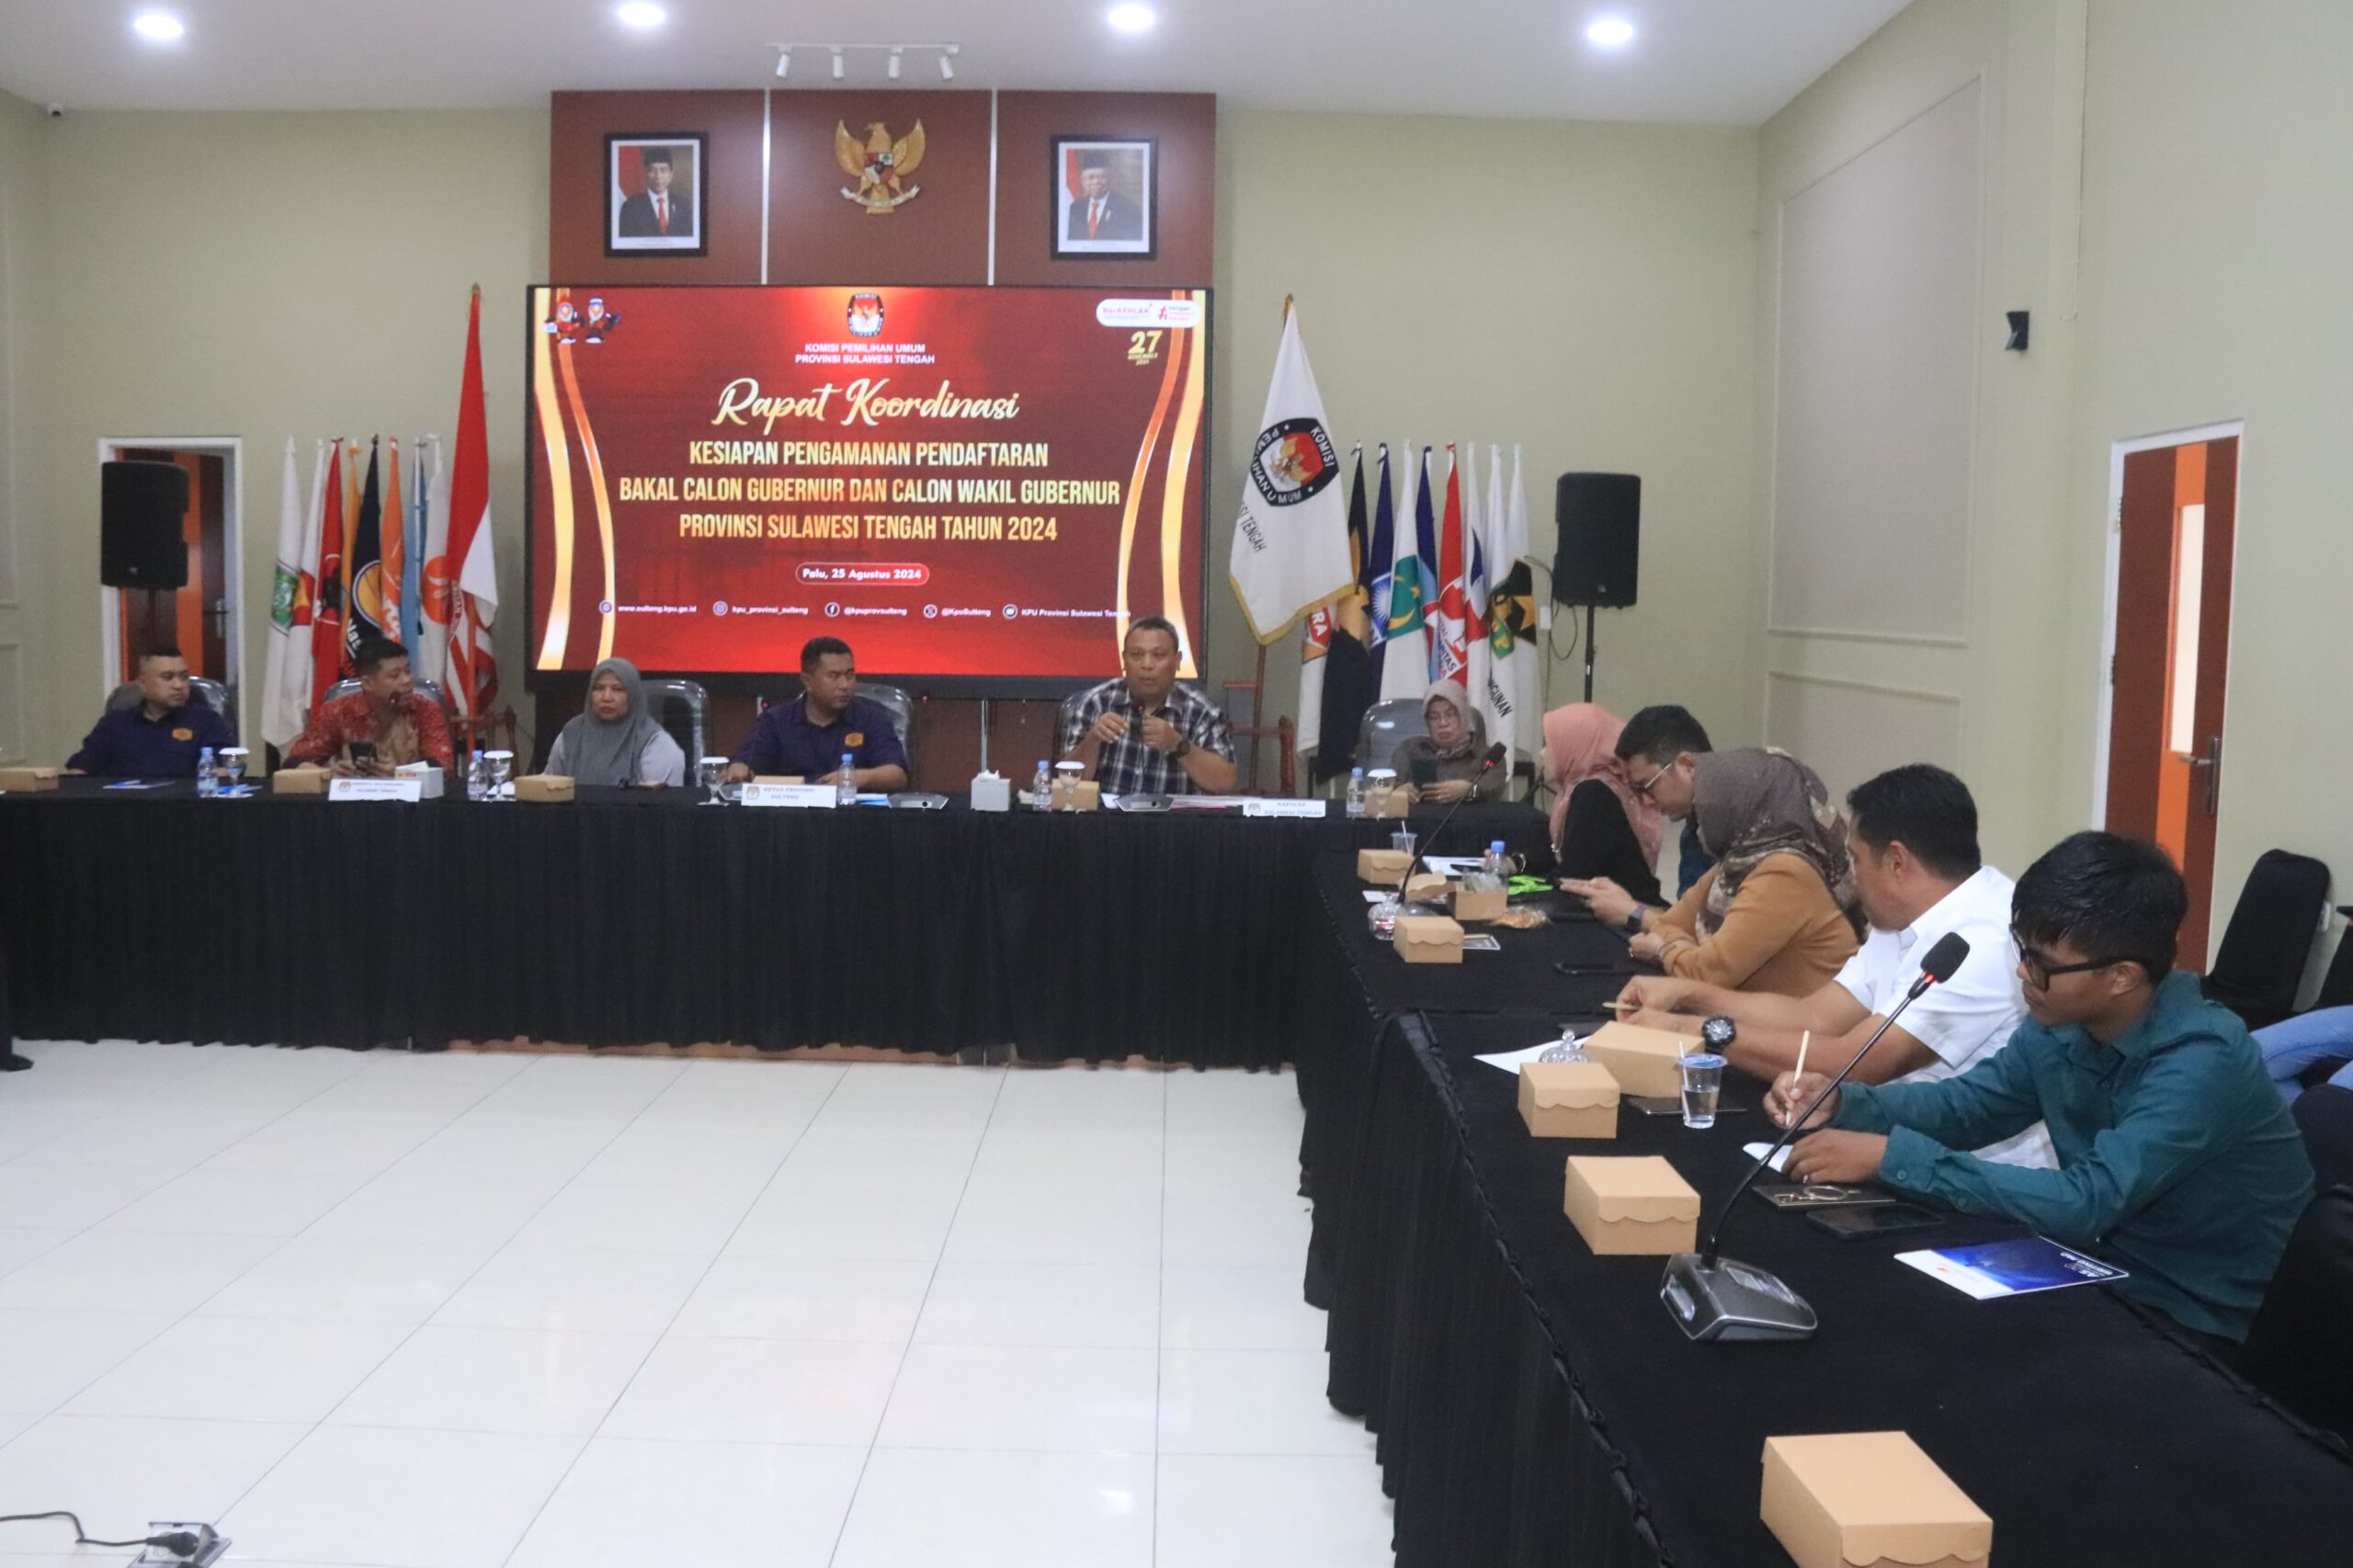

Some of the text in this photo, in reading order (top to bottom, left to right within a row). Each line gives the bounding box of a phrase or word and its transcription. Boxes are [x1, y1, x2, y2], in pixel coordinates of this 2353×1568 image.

[804, 344, 926, 353] KOMISI PEMILIHAN UMUM
[1128, 330, 1163, 355] 27
[795, 355, 935, 364] PROVINSI SULAWESI TENGAH
[711, 377, 1019, 436] Rapat Koordinasi
[689, 440, 1049, 467] KESIAPAN PENGAMANAN PENDAFTARAN
[1311, 426, 1335, 467] KOMISI
[1251, 426, 1302, 504] PEMIHAN UMUM
[620, 477, 1120, 505] BAKAL CALON GUBERNUR DAN CALON WAKIL GUBERNUR
[679, 514, 1058, 540] PROVINSI SULAWESI TENGAH TAHUN 2024
[1241, 517, 1267, 553] TENGAH
[802, 568, 922, 581] Palu, 25 Agustus 2024
[1021, 608, 1131, 618] KPU Provinsi Sulawesi Tenh
